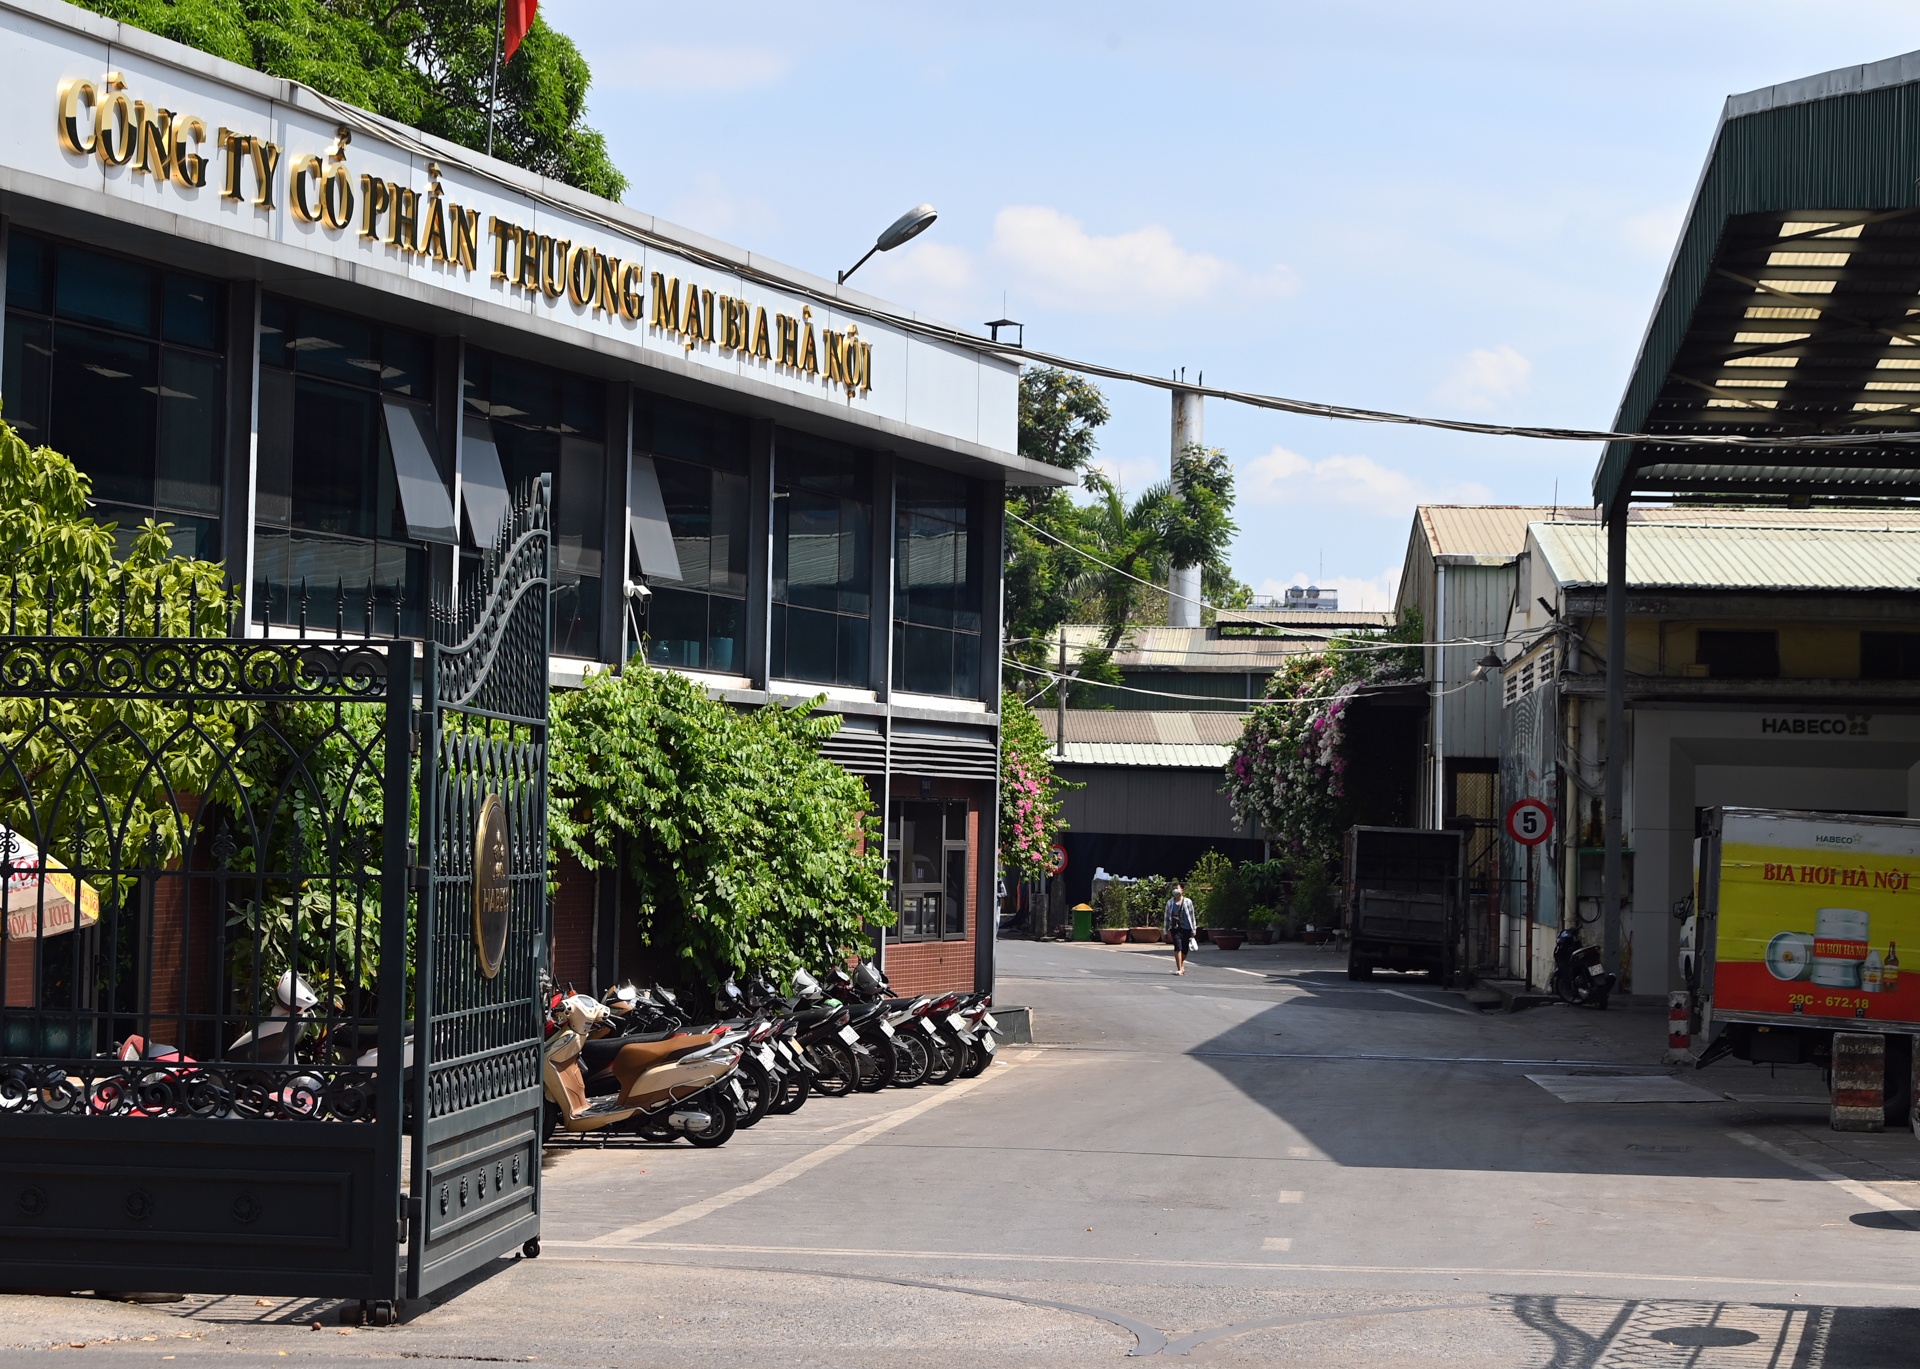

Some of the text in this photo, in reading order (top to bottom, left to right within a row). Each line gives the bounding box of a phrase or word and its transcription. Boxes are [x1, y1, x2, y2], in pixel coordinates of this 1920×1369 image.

[58, 71, 873, 399] CÔNG TY CỔ PHẦN THƯƠNG MẠI BIA HÀ NỘI
[1761, 718, 1847, 735] HABECO
[1523, 811, 1537, 834] 5
[1815, 834, 1853, 845] HABECO
[1763, 863, 1910, 894] BIA HƠI HÀ NỘI
[1788, 993, 1814, 1005] 29C
[1825, 996, 1869, 1009] 672.18
